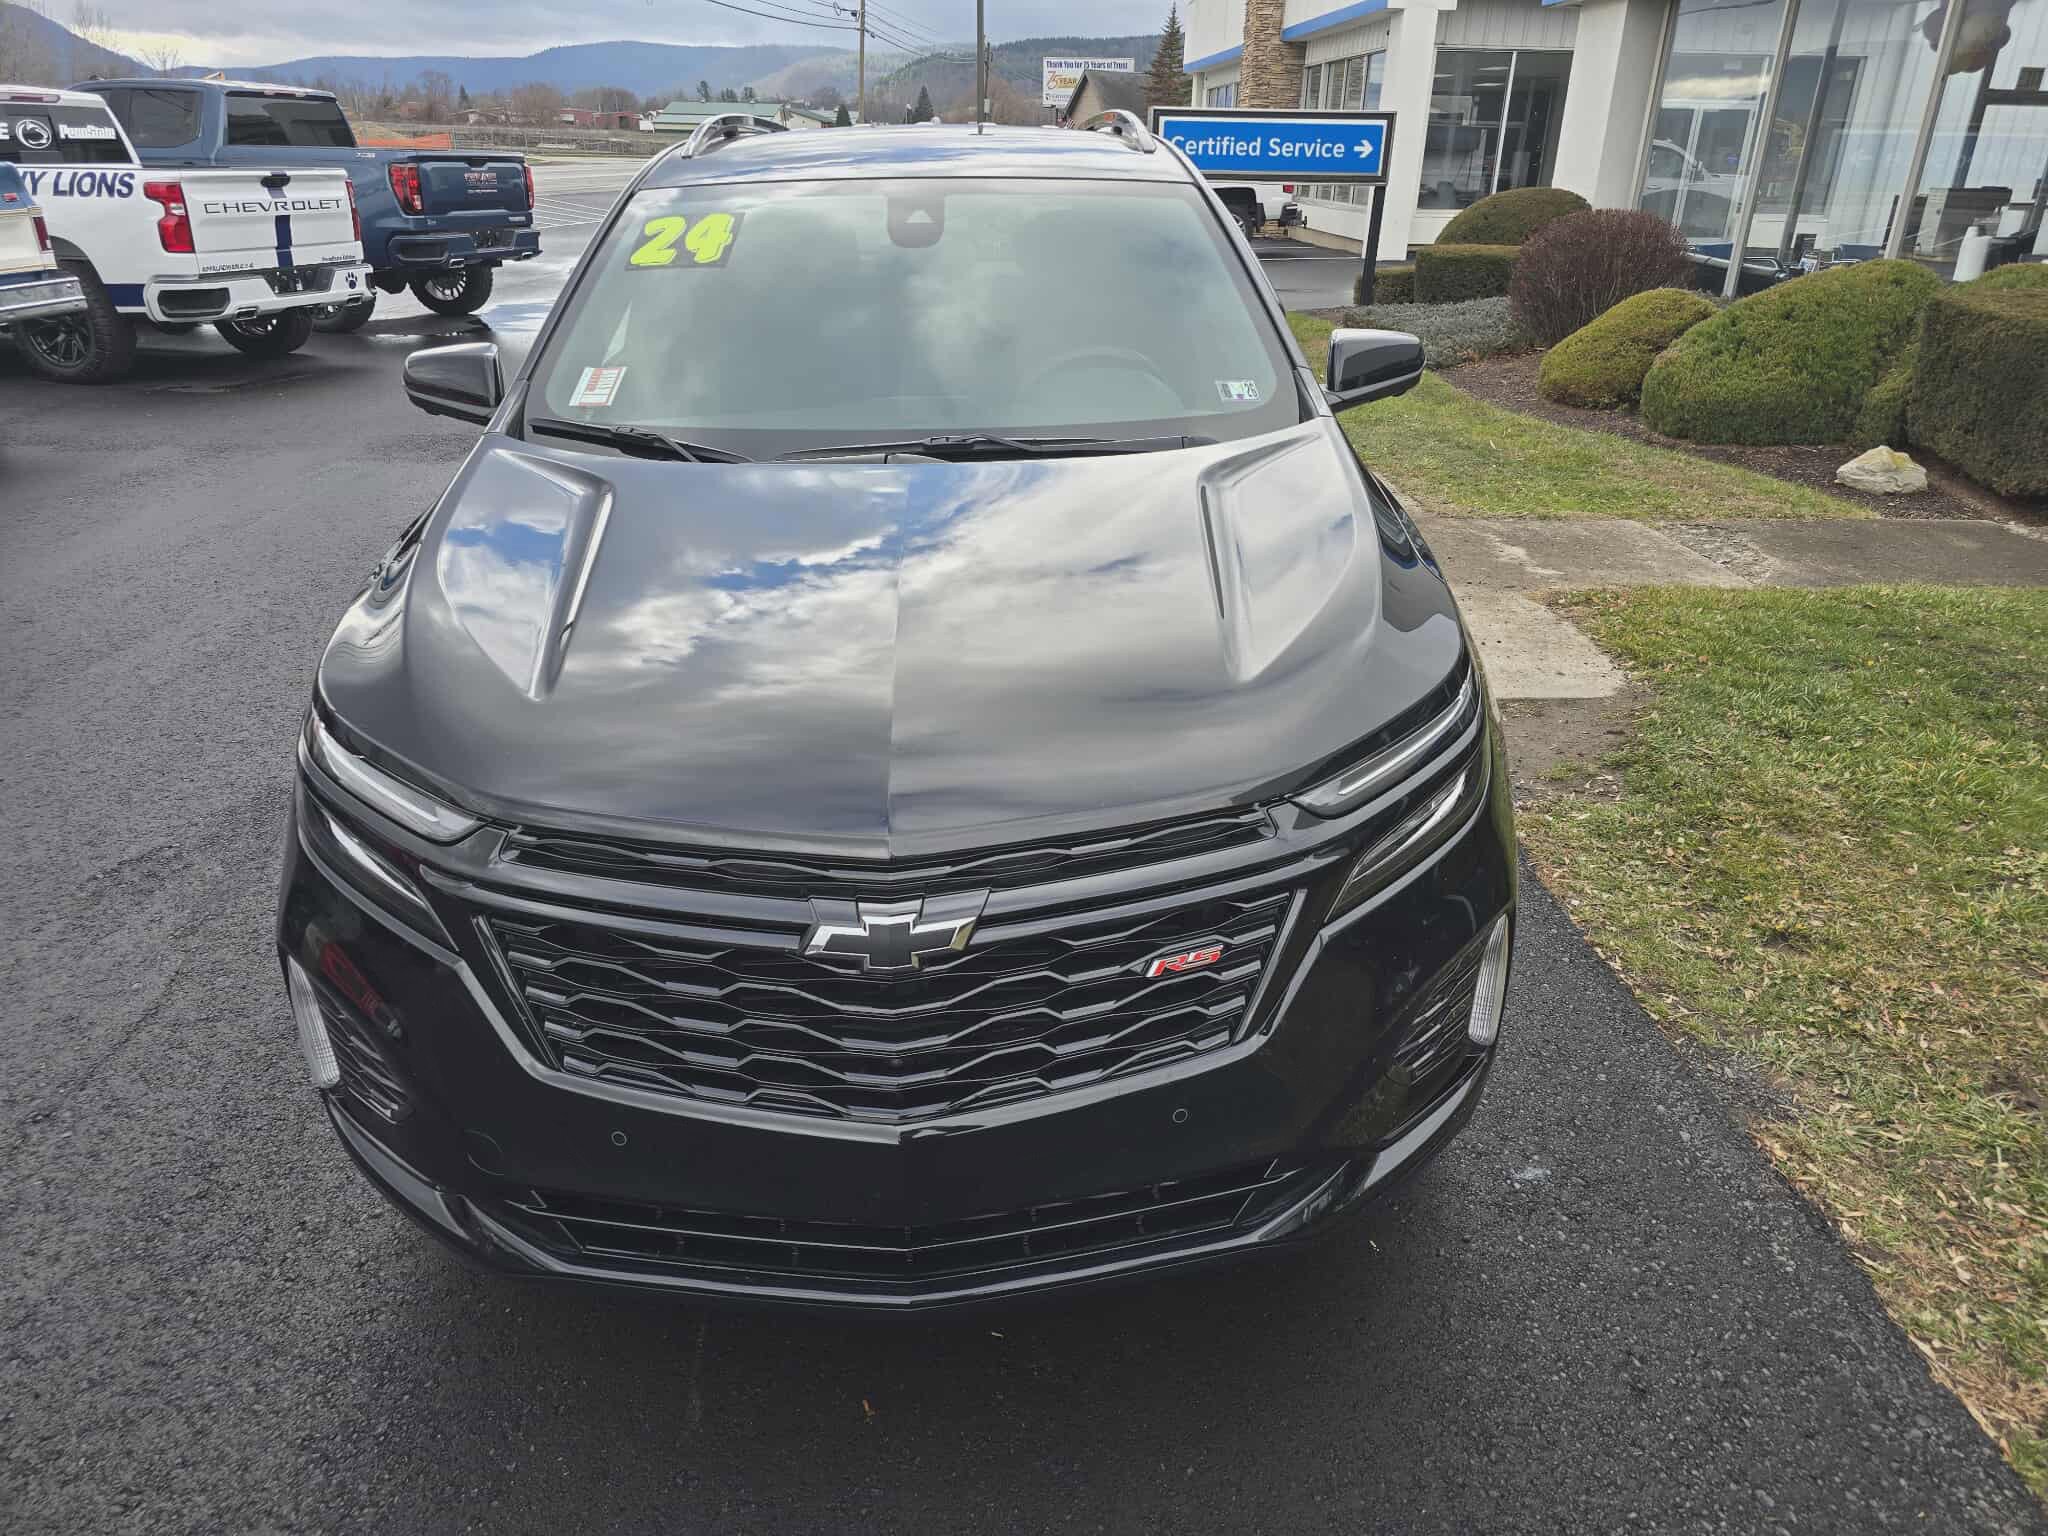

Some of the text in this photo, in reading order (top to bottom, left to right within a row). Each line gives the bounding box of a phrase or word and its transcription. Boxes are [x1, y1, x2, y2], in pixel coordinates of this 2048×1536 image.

[1046, 60, 1062, 69] Thank
[1063, 61, 1074, 69] You
[1091, 61, 1106, 70] Years
[1113, 62, 1128, 70] Trust
[1171, 136, 1345, 158] Certified Service
[53, 171, 135, 198] LIONS
[204, 200, 342, 214] CHEVROLET
[630, 213, 734, 266] 24
[1145, 945, 1224, 977] RS
